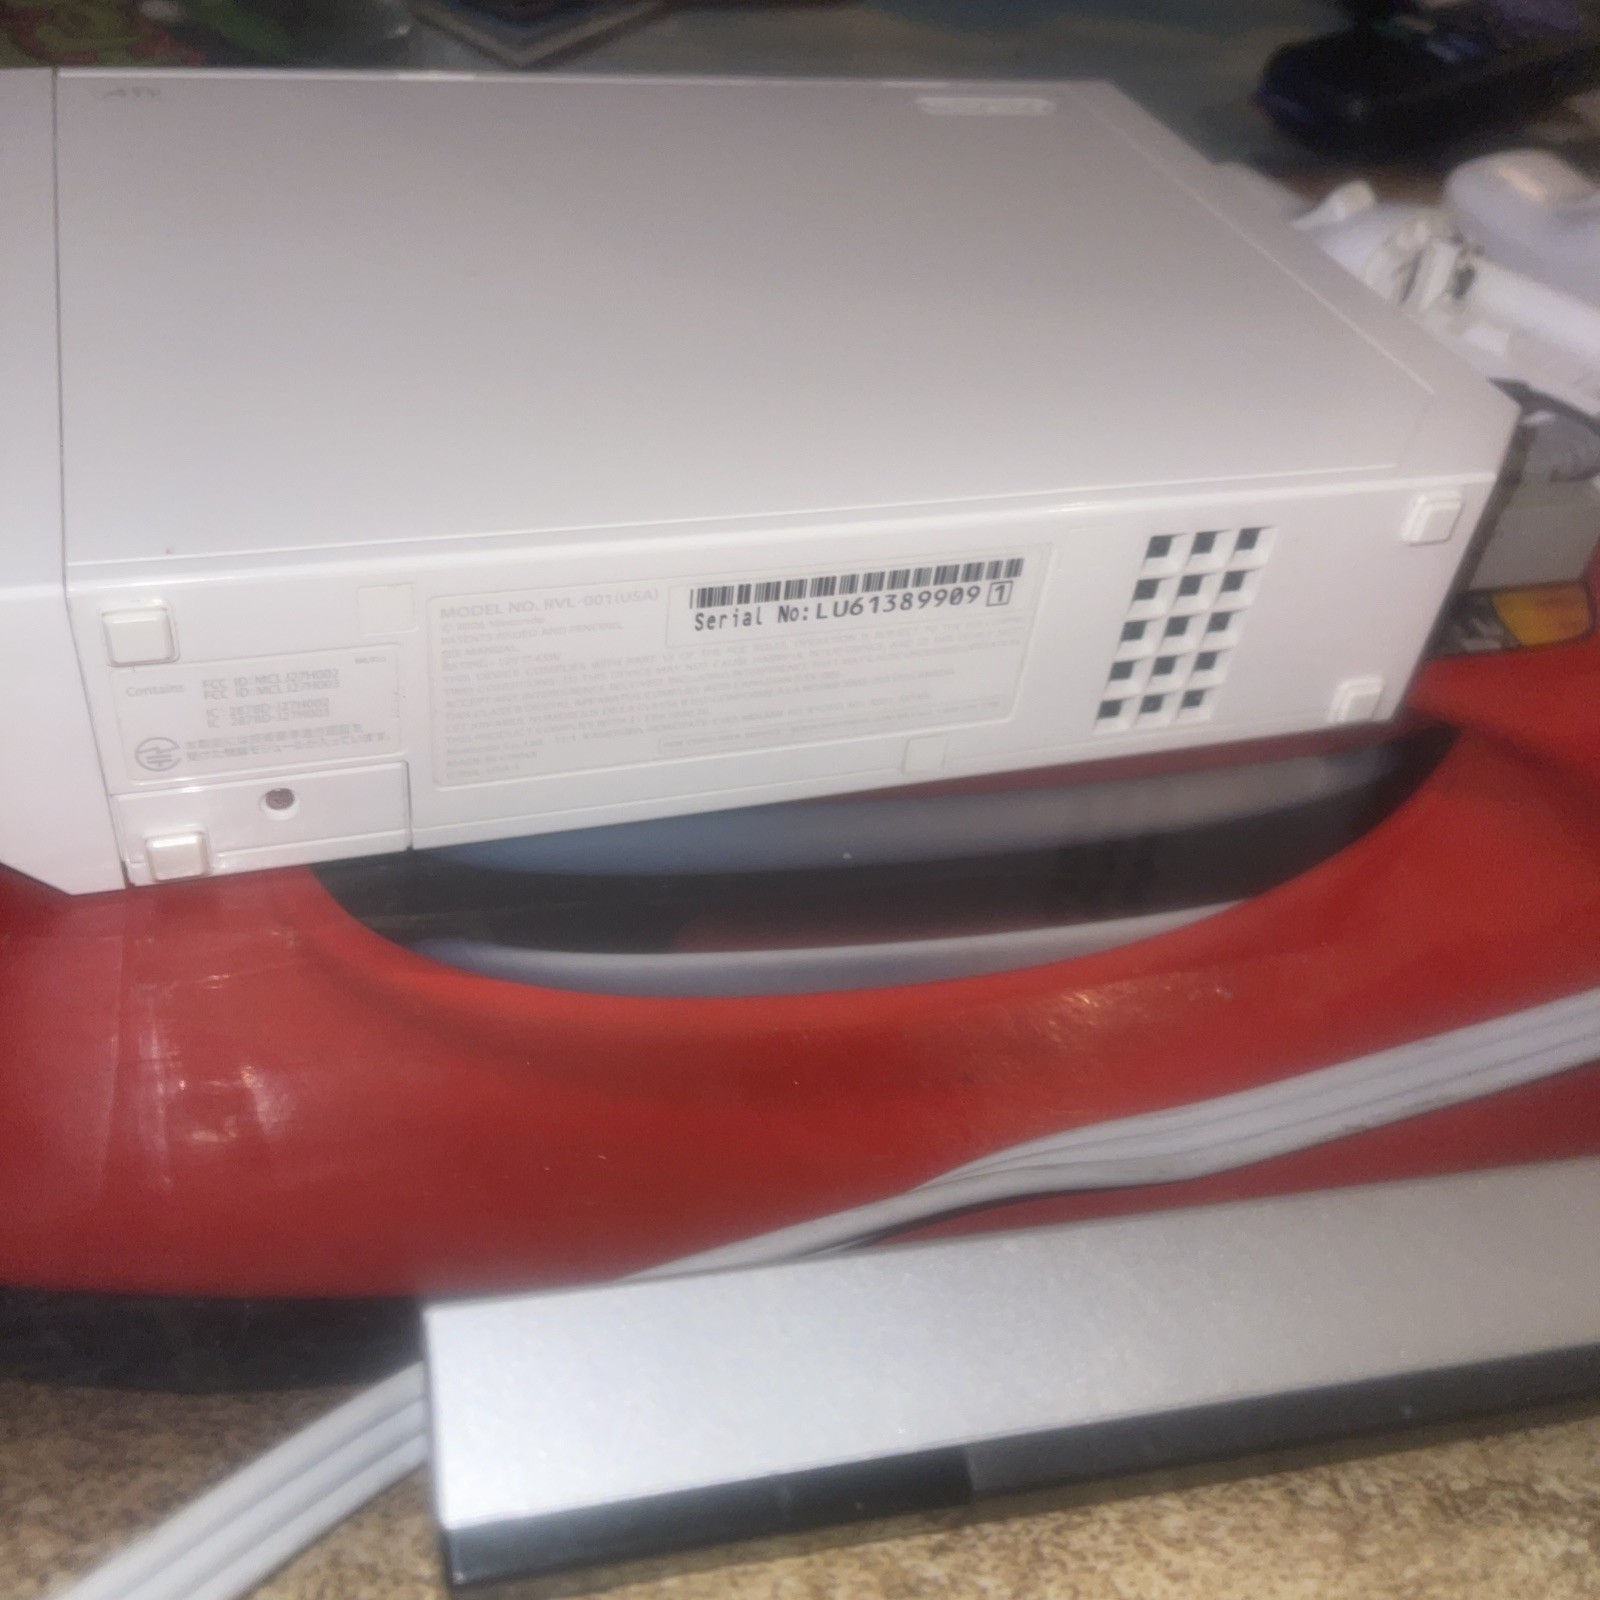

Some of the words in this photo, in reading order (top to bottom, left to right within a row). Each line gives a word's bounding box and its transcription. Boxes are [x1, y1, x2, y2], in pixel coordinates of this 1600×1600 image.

[440, 603, 504, 619] MODEL
[694, 607, 762, 632] Serial
[126, 684, 185, 697] Contains
